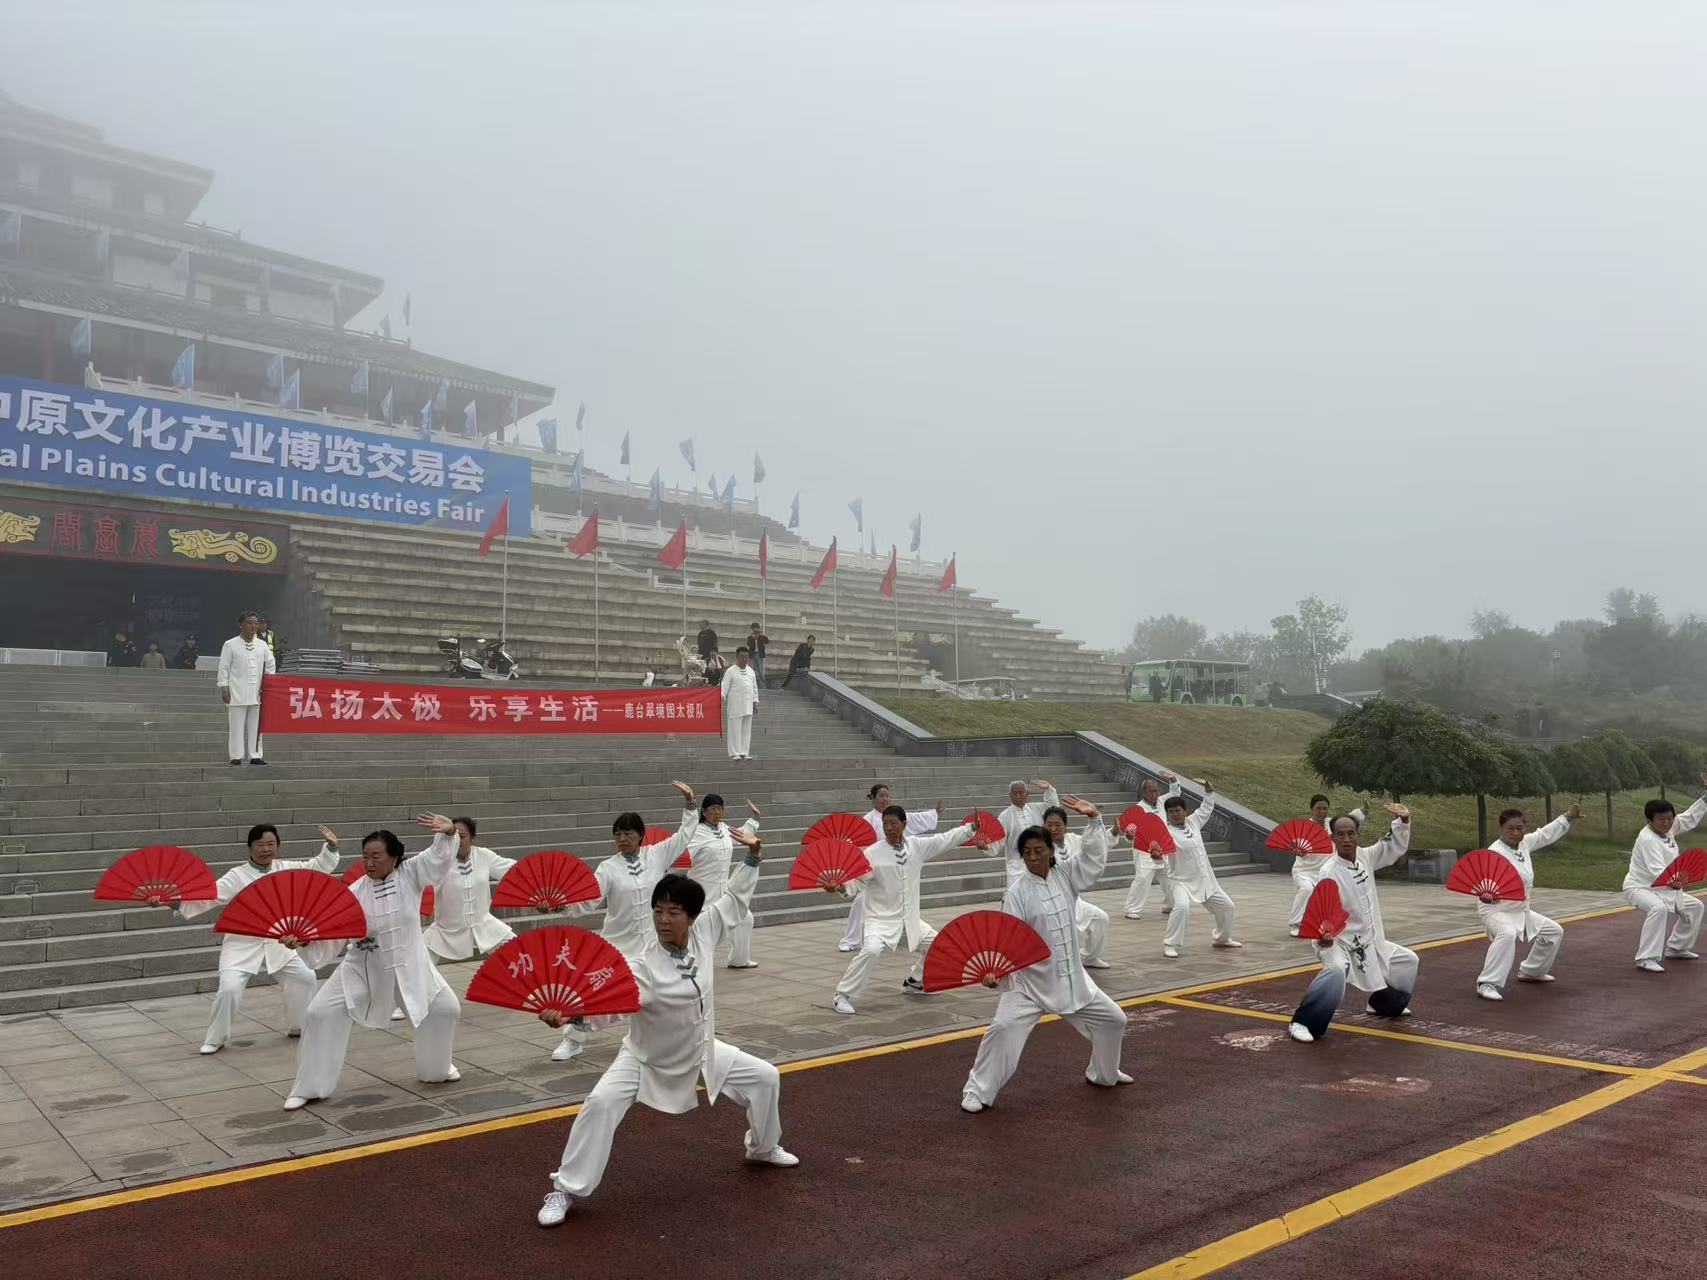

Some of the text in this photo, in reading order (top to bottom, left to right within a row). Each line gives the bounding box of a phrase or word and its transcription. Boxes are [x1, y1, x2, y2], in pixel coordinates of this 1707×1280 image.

[0, 389, 485, 494] 原文化产业博览交易会
[41, 447, 147, 483] Plains
[155, 463, 284, 498] Cultural
[292, 479, 431, 517] Industries
[437, 498, 485, 523] Fair
[289, 687, 442, 720] 弘扬太极
[468, 694, 599, 722] 乐享生活
